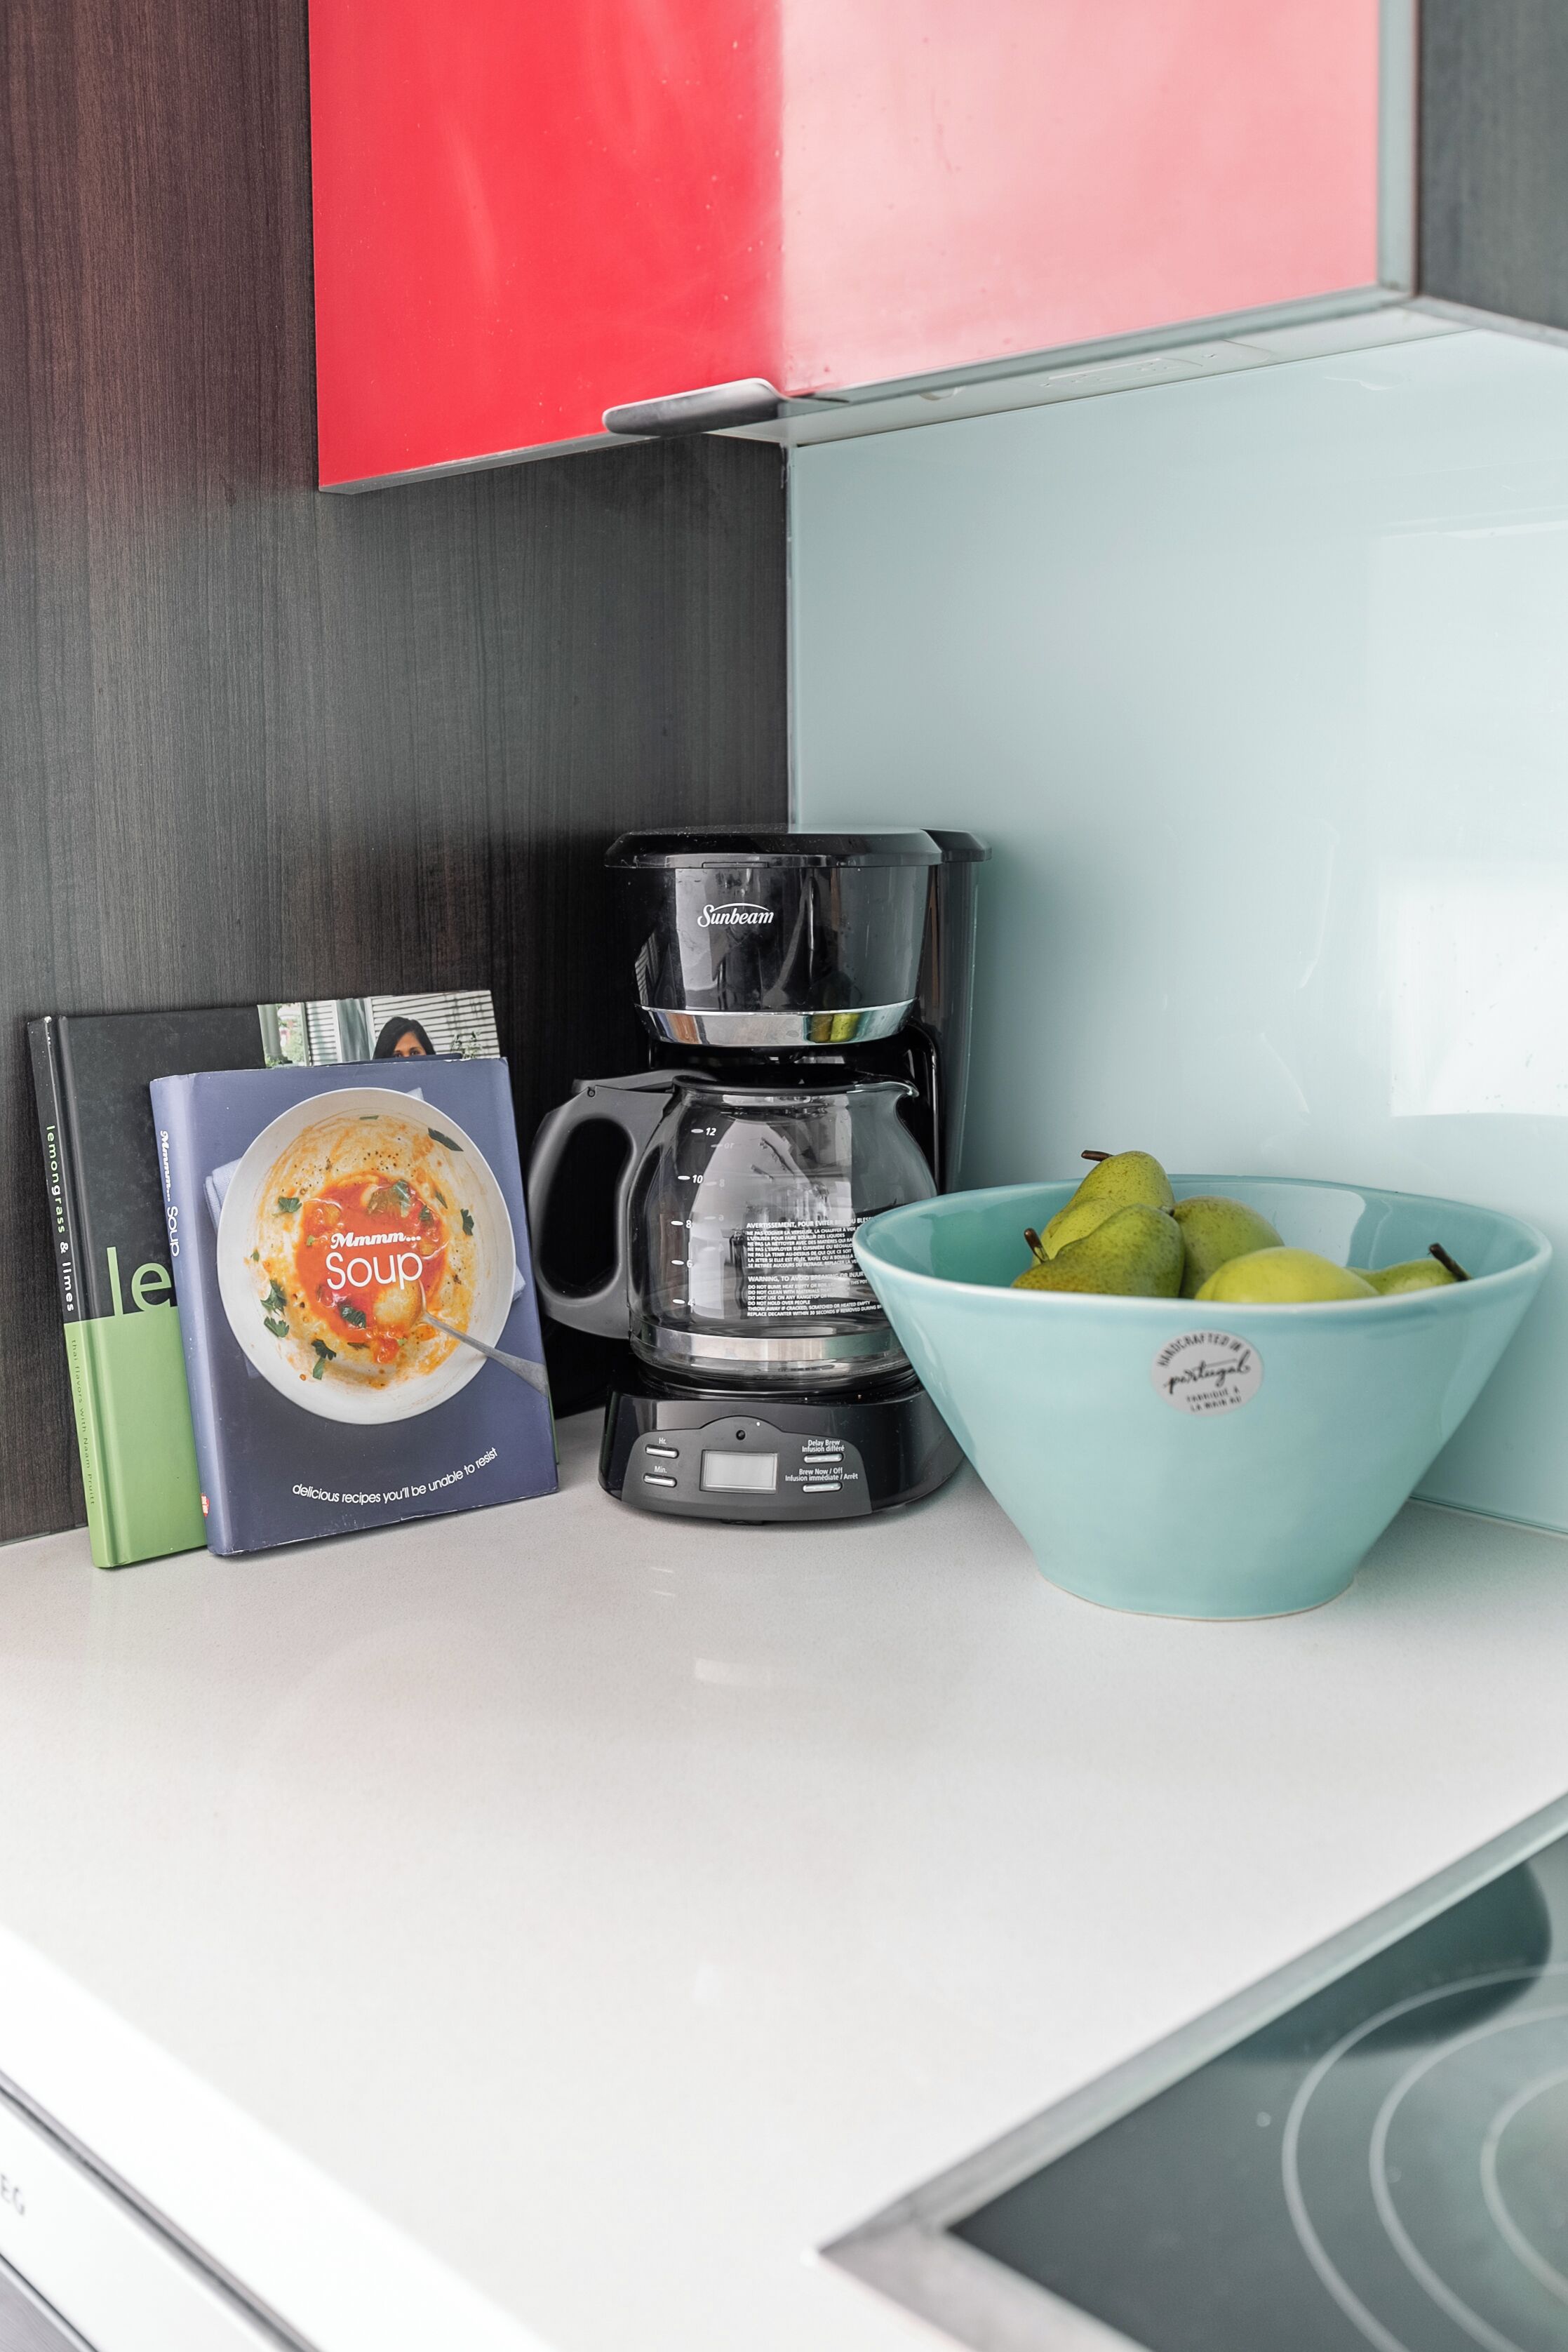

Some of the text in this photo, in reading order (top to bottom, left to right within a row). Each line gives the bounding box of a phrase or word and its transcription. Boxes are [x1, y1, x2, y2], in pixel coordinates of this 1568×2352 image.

[697, 903, 774, 927] Sunbeam
[705, 1127, 716, 1136] 12
[692, 1174, 703, 1184] 10
[46, 1125, 74, 1311] lemongrass & limes
[685, 1220, 692, 1229] 8
[167, 1205, 180, 1257] Soup
[330, 1231, 421, 1250] Mmmm...
[326, 1252, 423, 1290] Soup
[686, 1259, 693, 1269] 6
[1157, 1332, 1242, 1367] HANDCRAFTED IN
[1162, 1349, 1252, 1395] portugal
[292, 1483, 340, 1503] delicious
[342, 1491, 381, 1505] recipes
[411, 1485, 427, 1497] be
[428, 1471, 464, 1492] unable
[464, 1463, 476, 1476] to
[476, 1447, 498, 1469] resist
[654, 1465, 667, 1474] Min.
